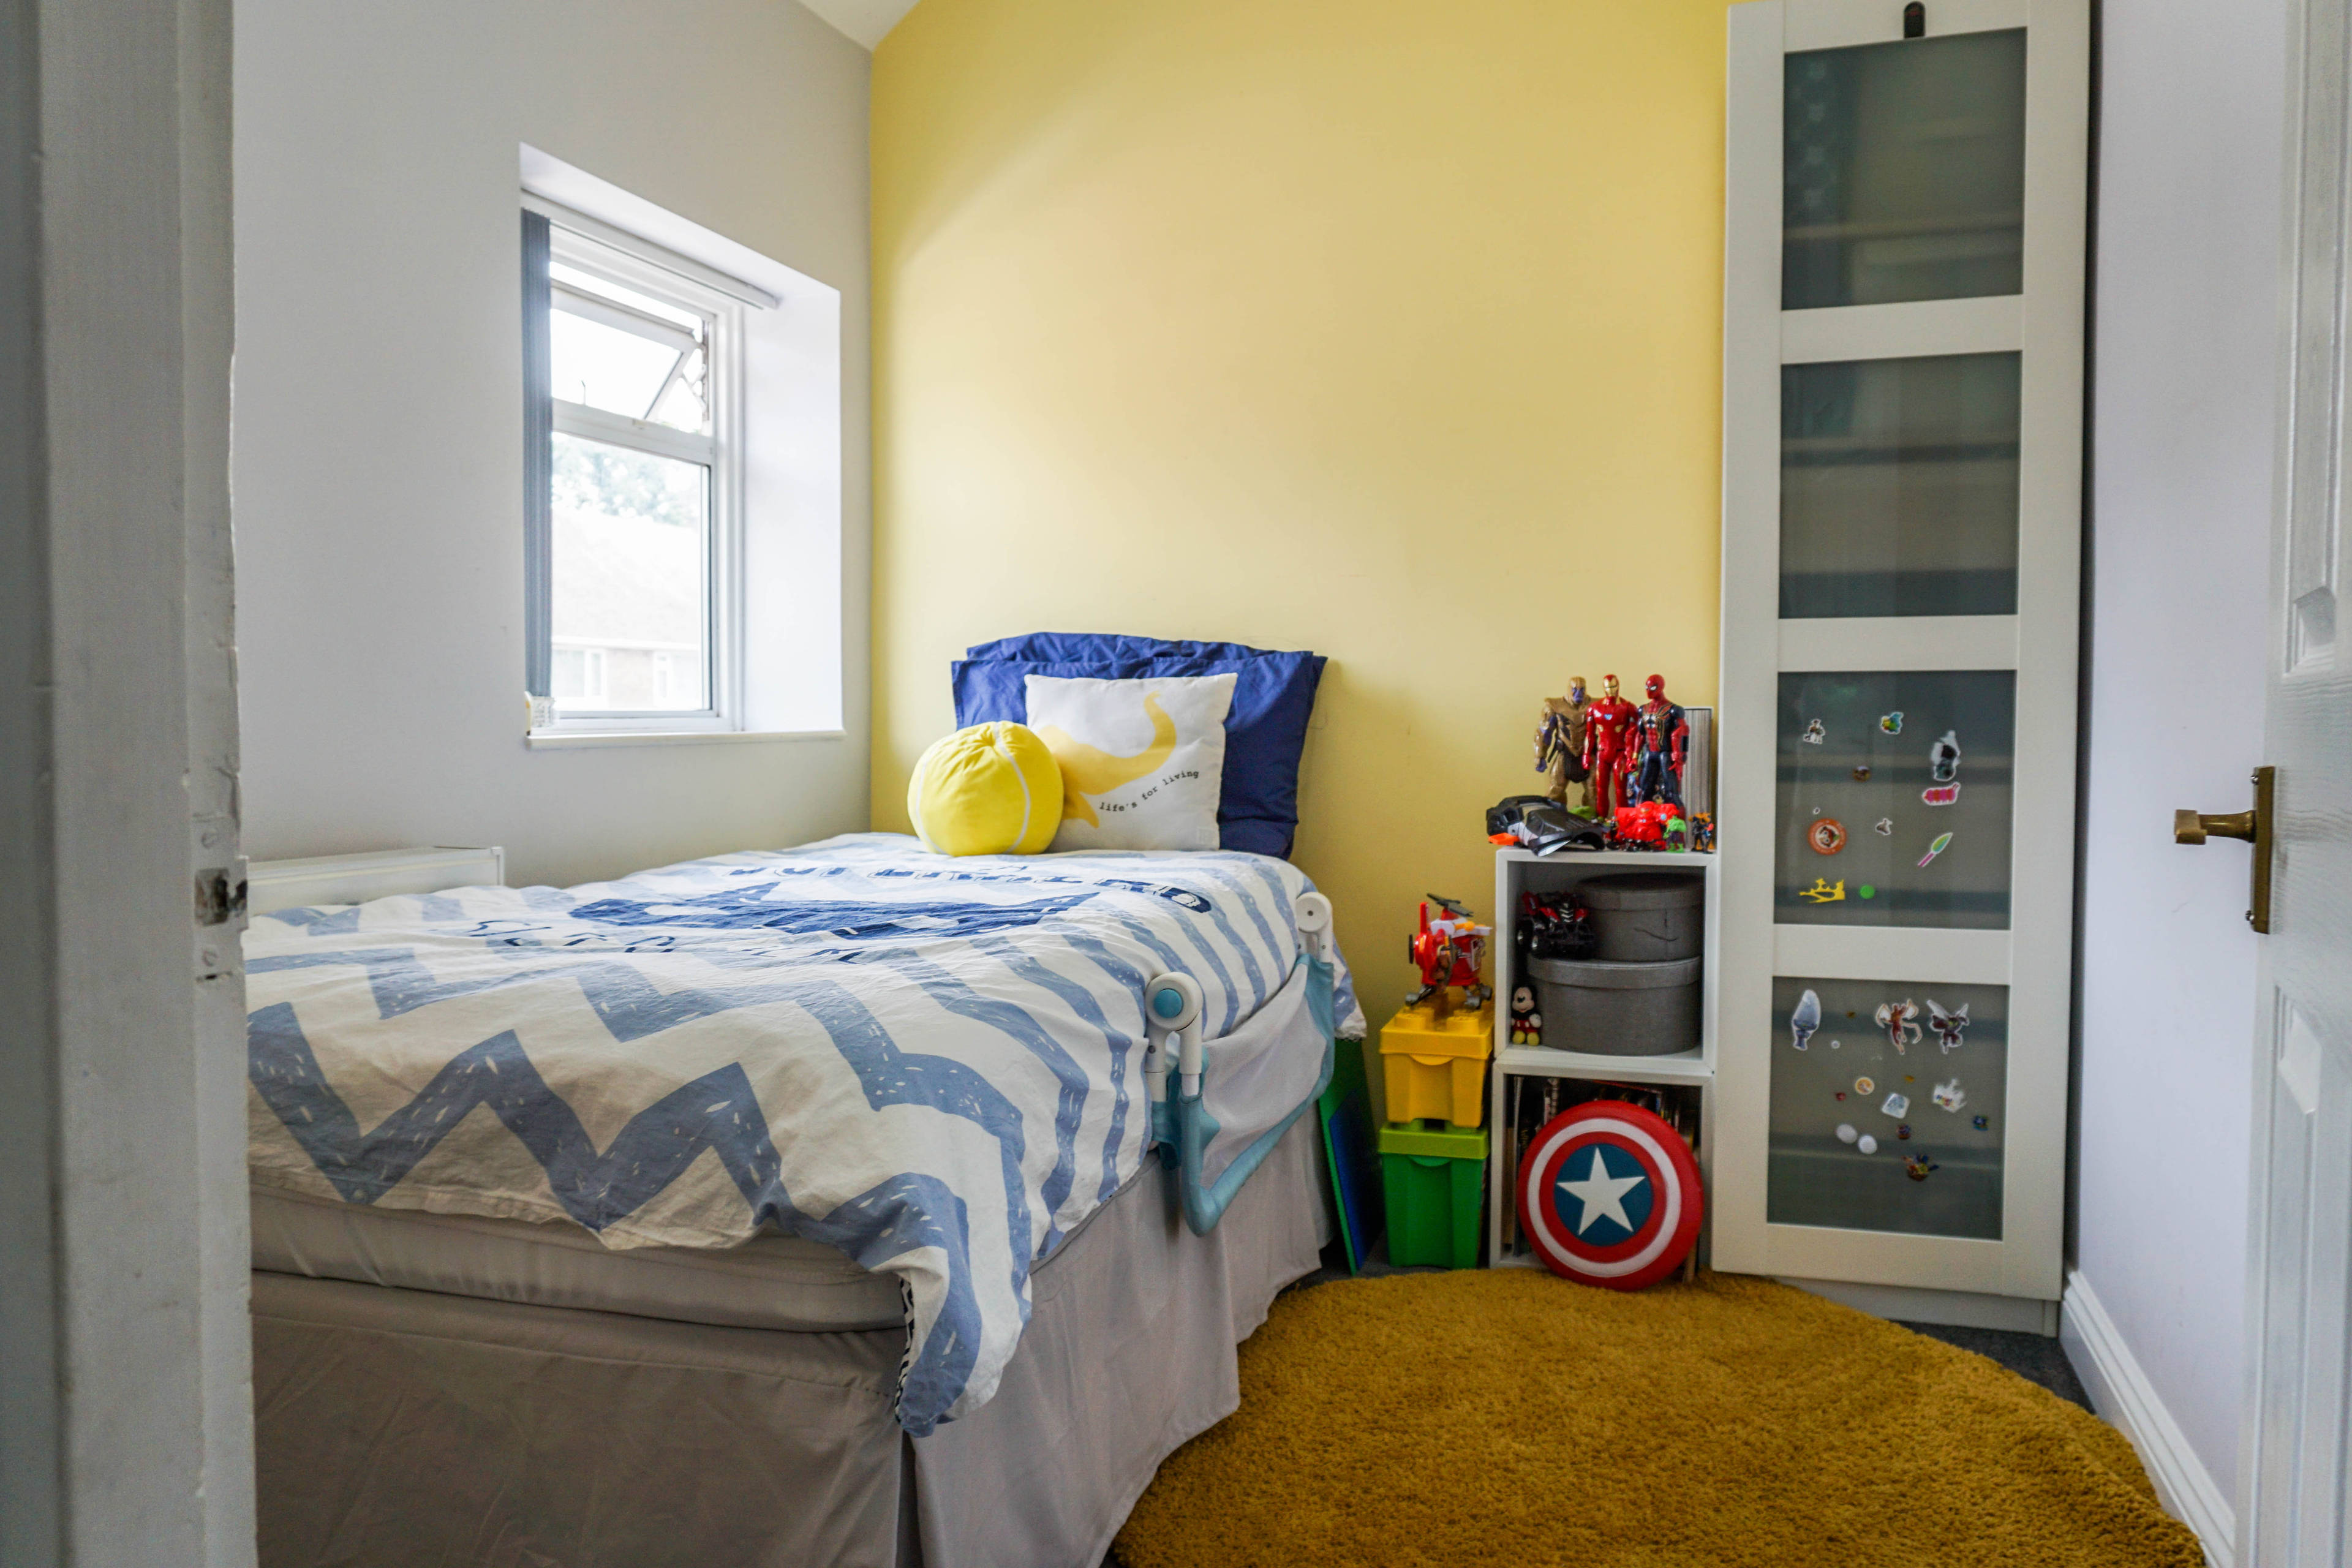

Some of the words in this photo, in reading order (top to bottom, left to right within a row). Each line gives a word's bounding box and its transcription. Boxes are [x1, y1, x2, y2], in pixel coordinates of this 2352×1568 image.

[1099, 801, 1137, 812] life's
[1142, 786, 1158, 800] for
[1163, 770, 1199, 785] living
